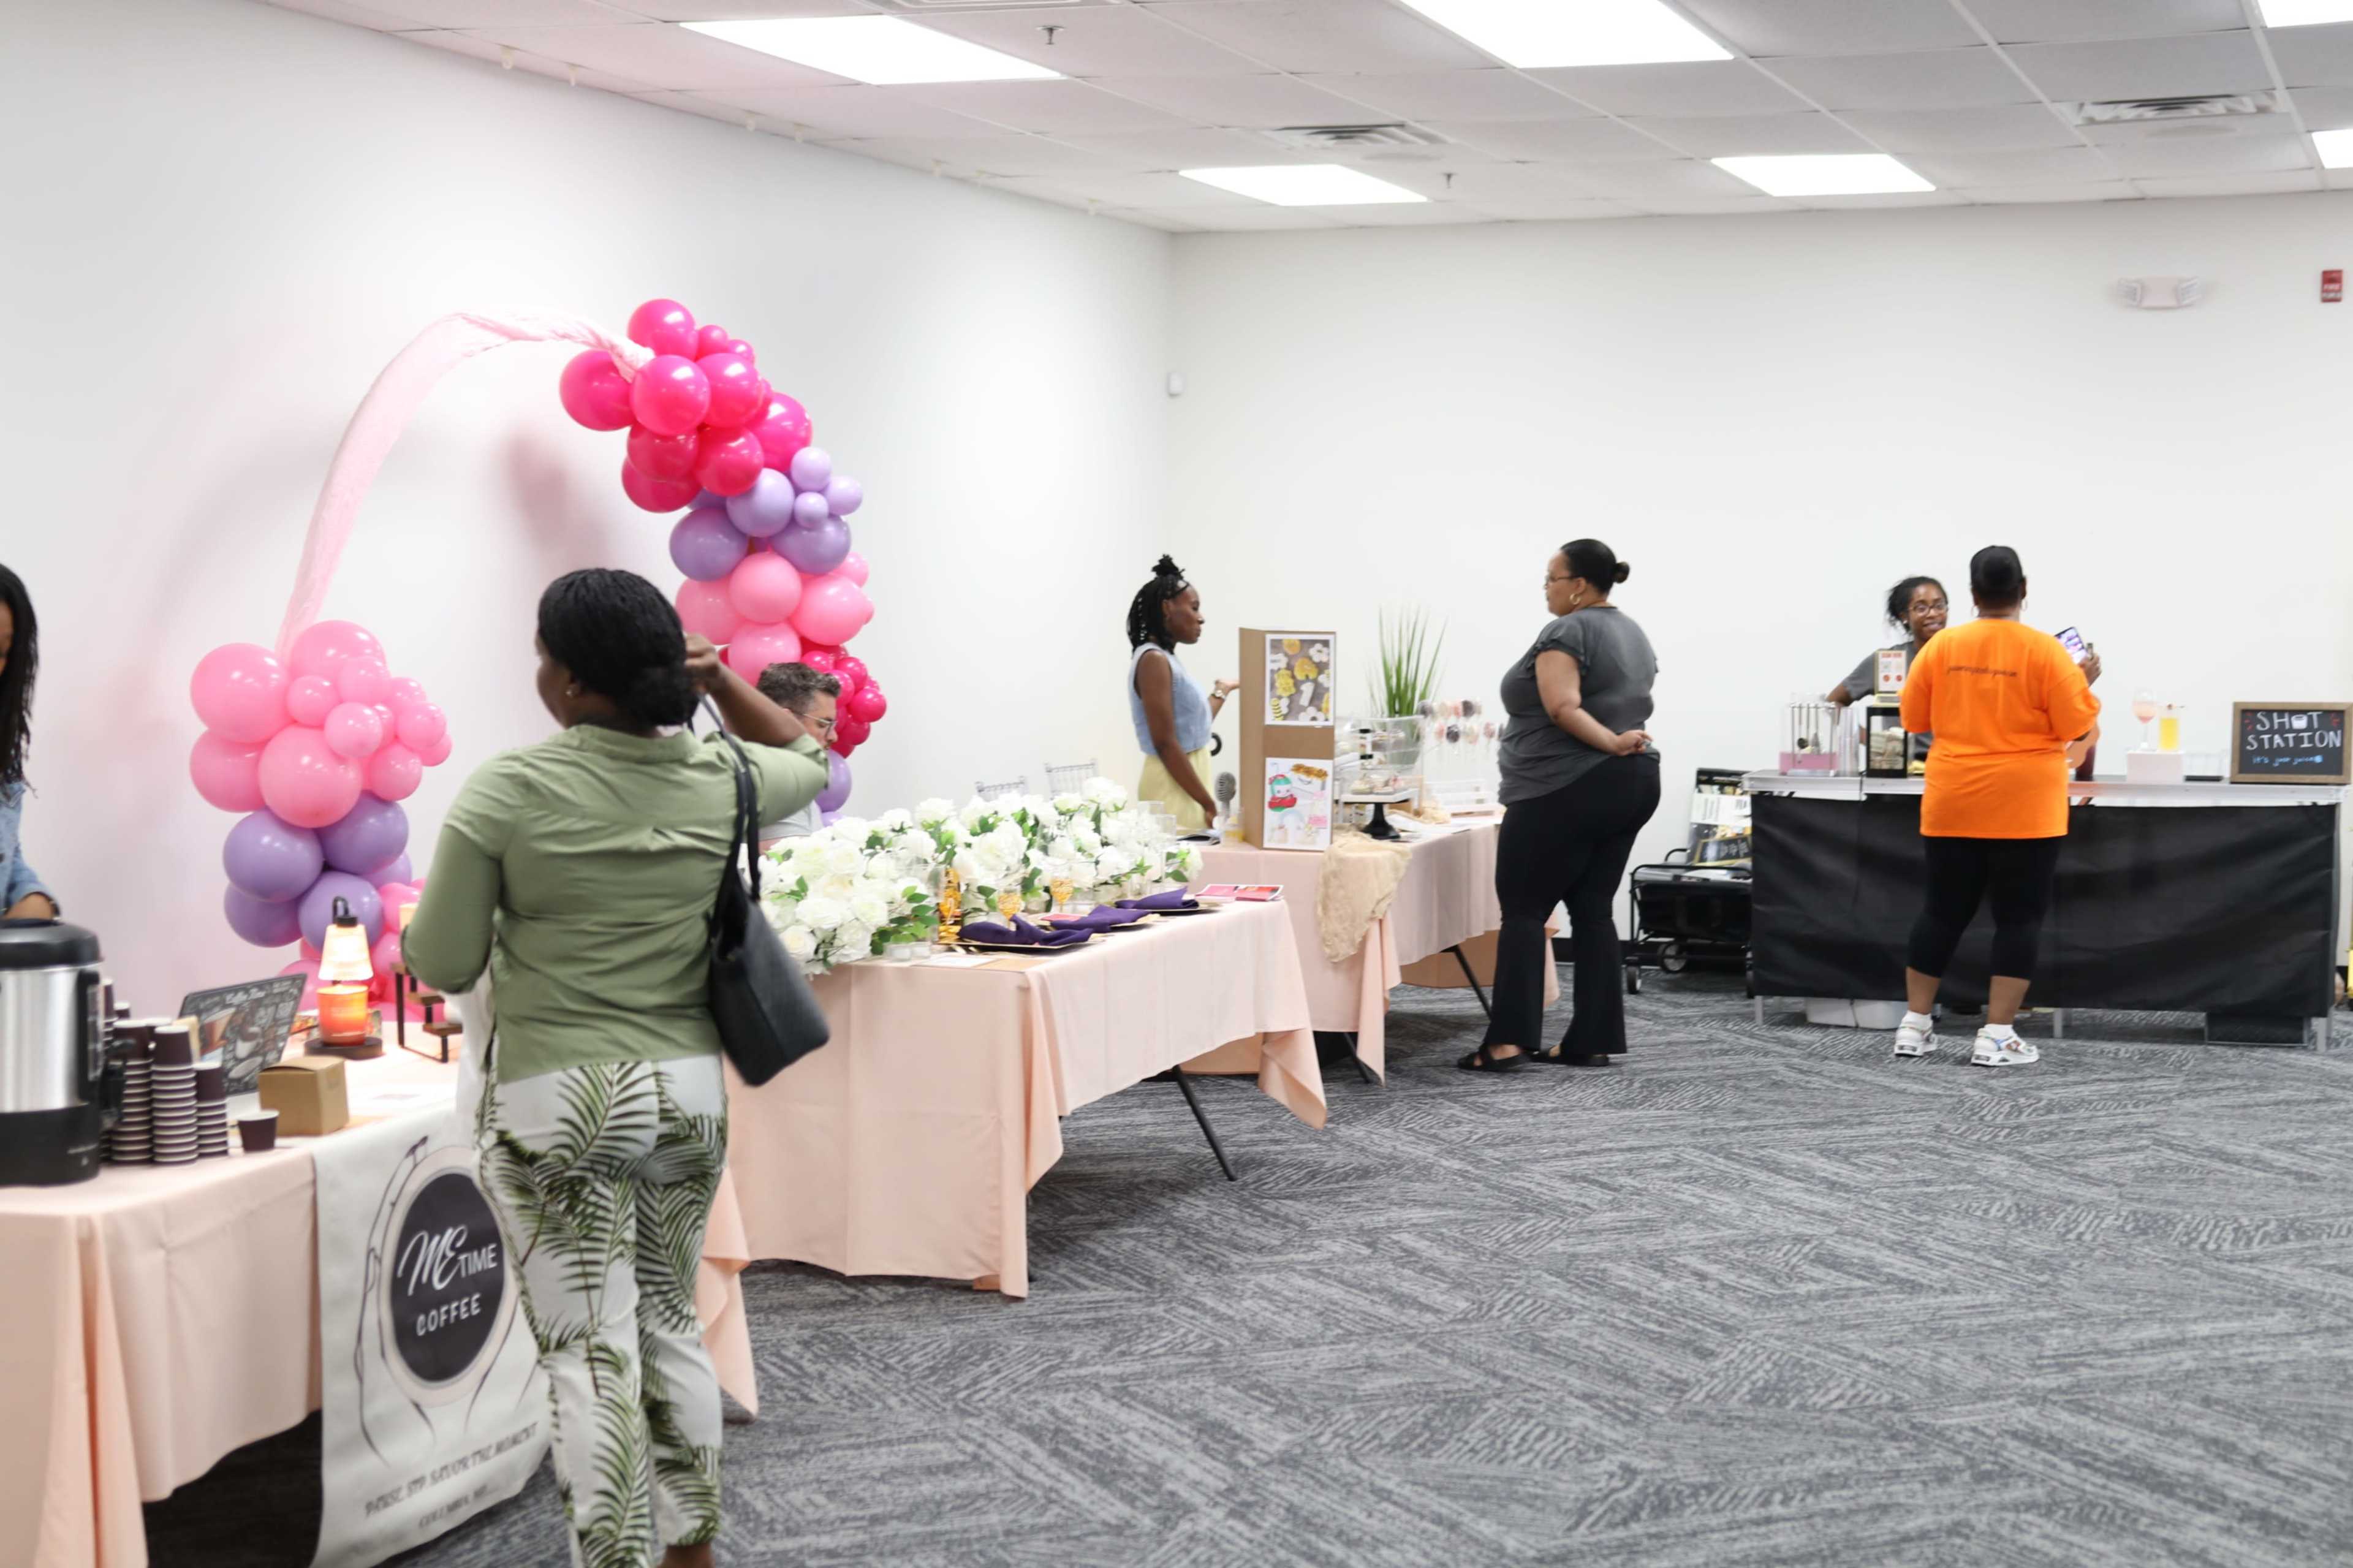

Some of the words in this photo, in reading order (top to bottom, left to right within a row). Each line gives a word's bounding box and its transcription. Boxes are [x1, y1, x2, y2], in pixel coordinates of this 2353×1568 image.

[2246, 730, 2342, 750] STATION
[458, 1243, 498, 1278] TIME
[416, 1292, 482, 1337] COFFEE
